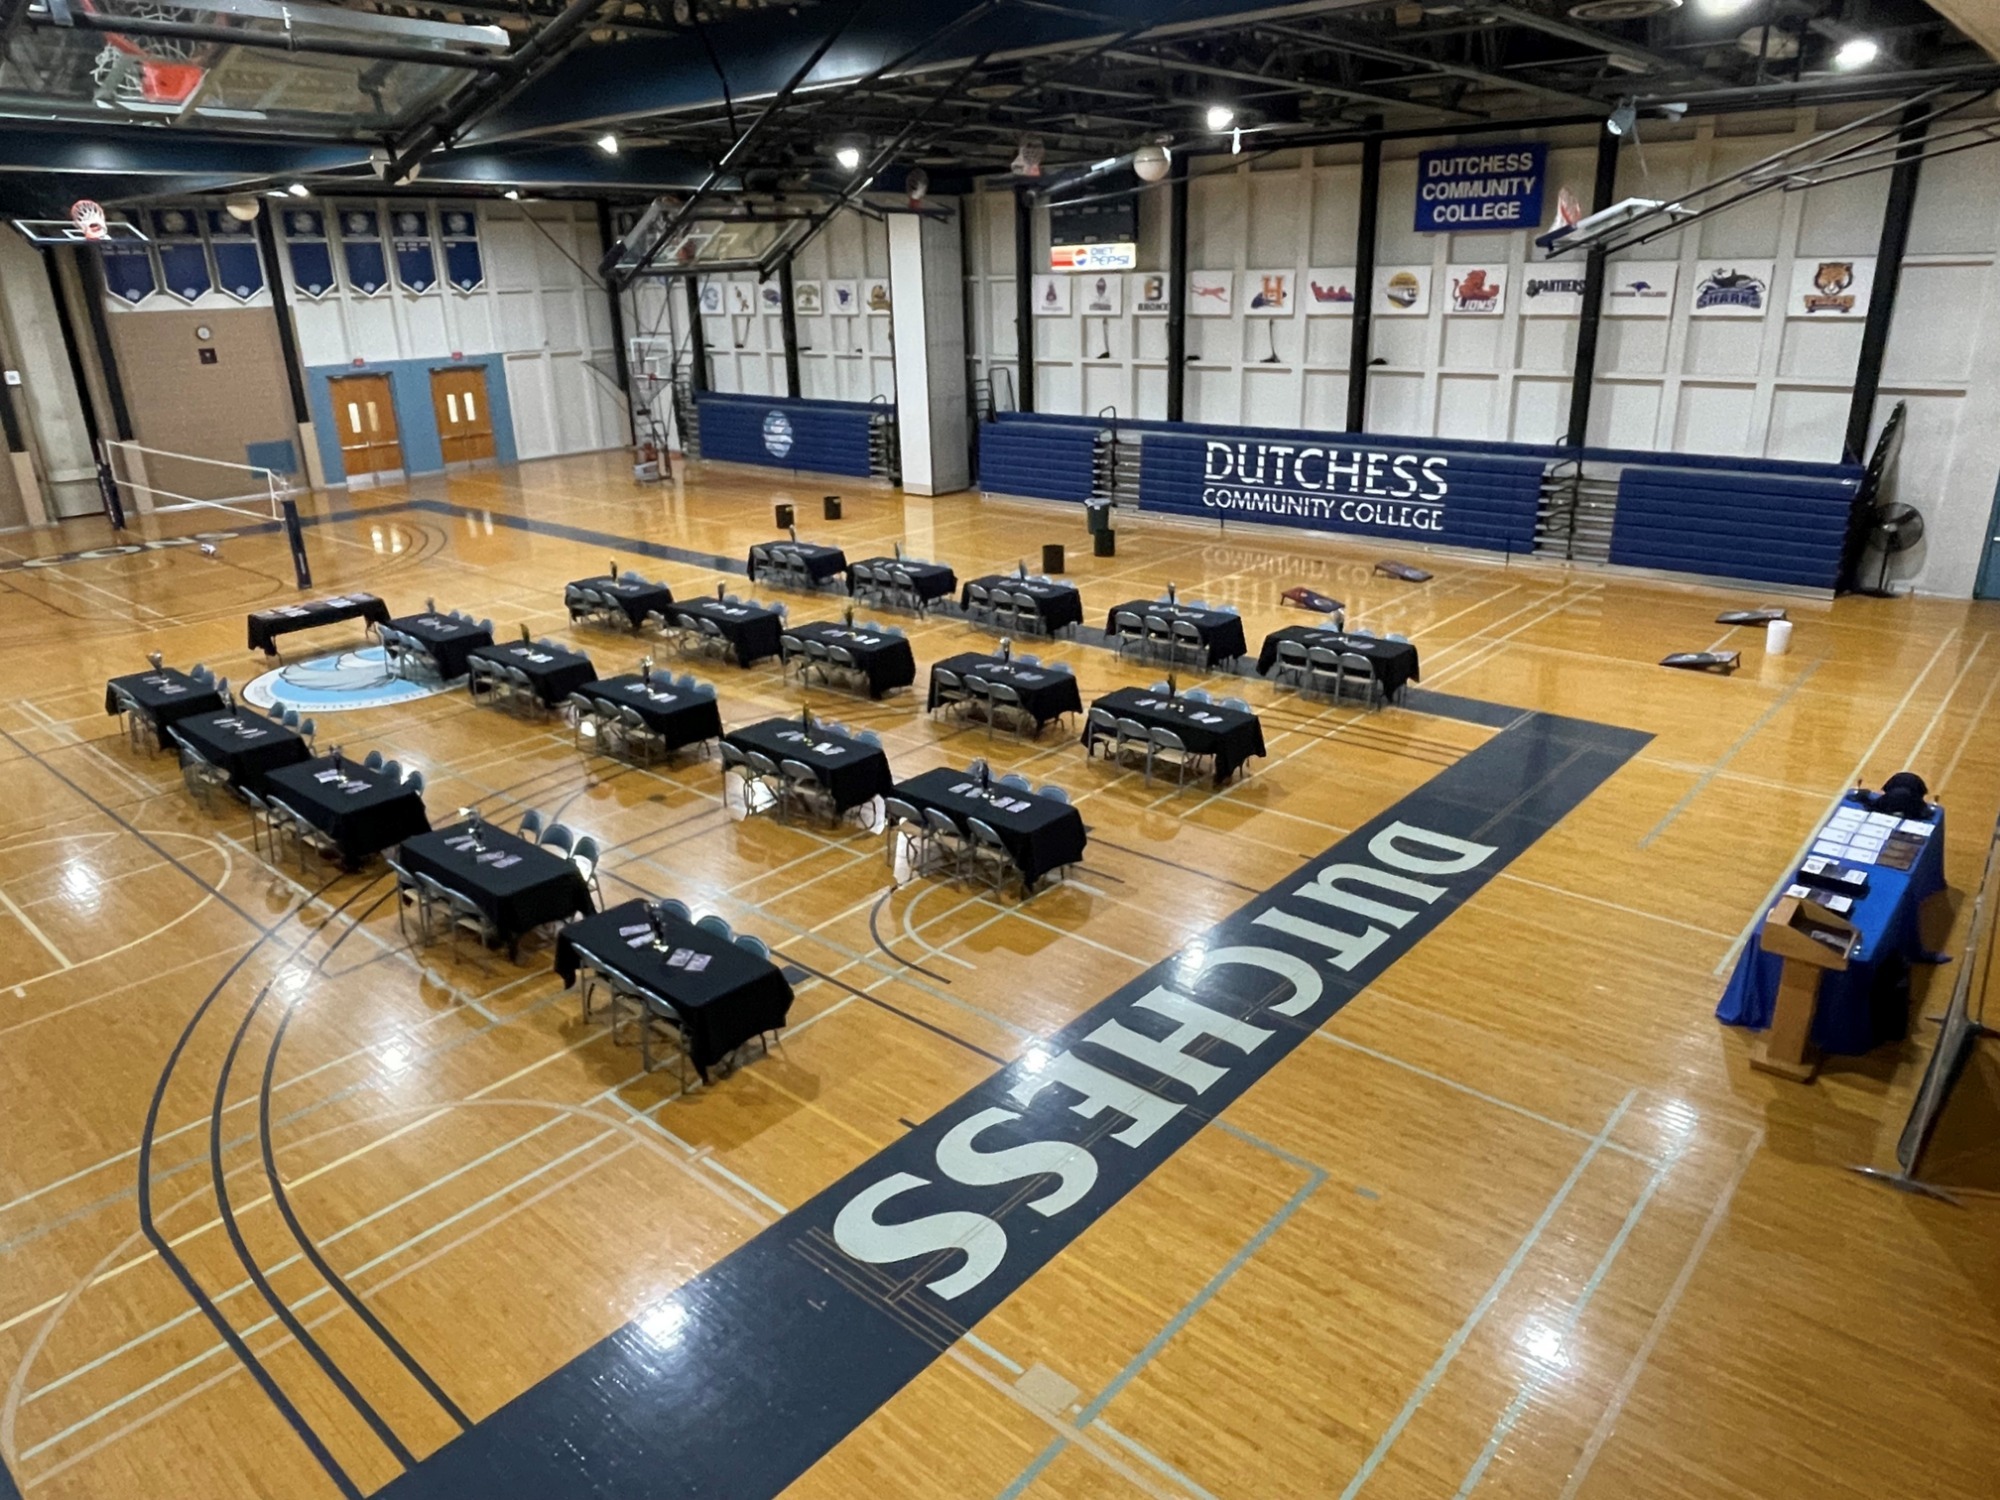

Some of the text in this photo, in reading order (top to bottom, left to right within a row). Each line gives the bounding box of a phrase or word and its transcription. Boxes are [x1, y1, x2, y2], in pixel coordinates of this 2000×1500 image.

[1428, 152, 1533, 177] DUTCHESS
[1422, 176, 1536, 200] COMMUNITY
[1433, 201, 1521, 222] COLLEGE
[1090, 246, 1114, 256] DIET
[1090, 255, 1130, 265] PEPSI
[1536, 279, 1586, 293] PANTHERS
[1452, 296, 1497, 312] LIONS
[1203, 441, 1448, 501] DUTCHESS
[1202, 487, 1444, 531] COMMUNITY COLLEGE
[833, 820, 1500, 1301] DUTCHESS
